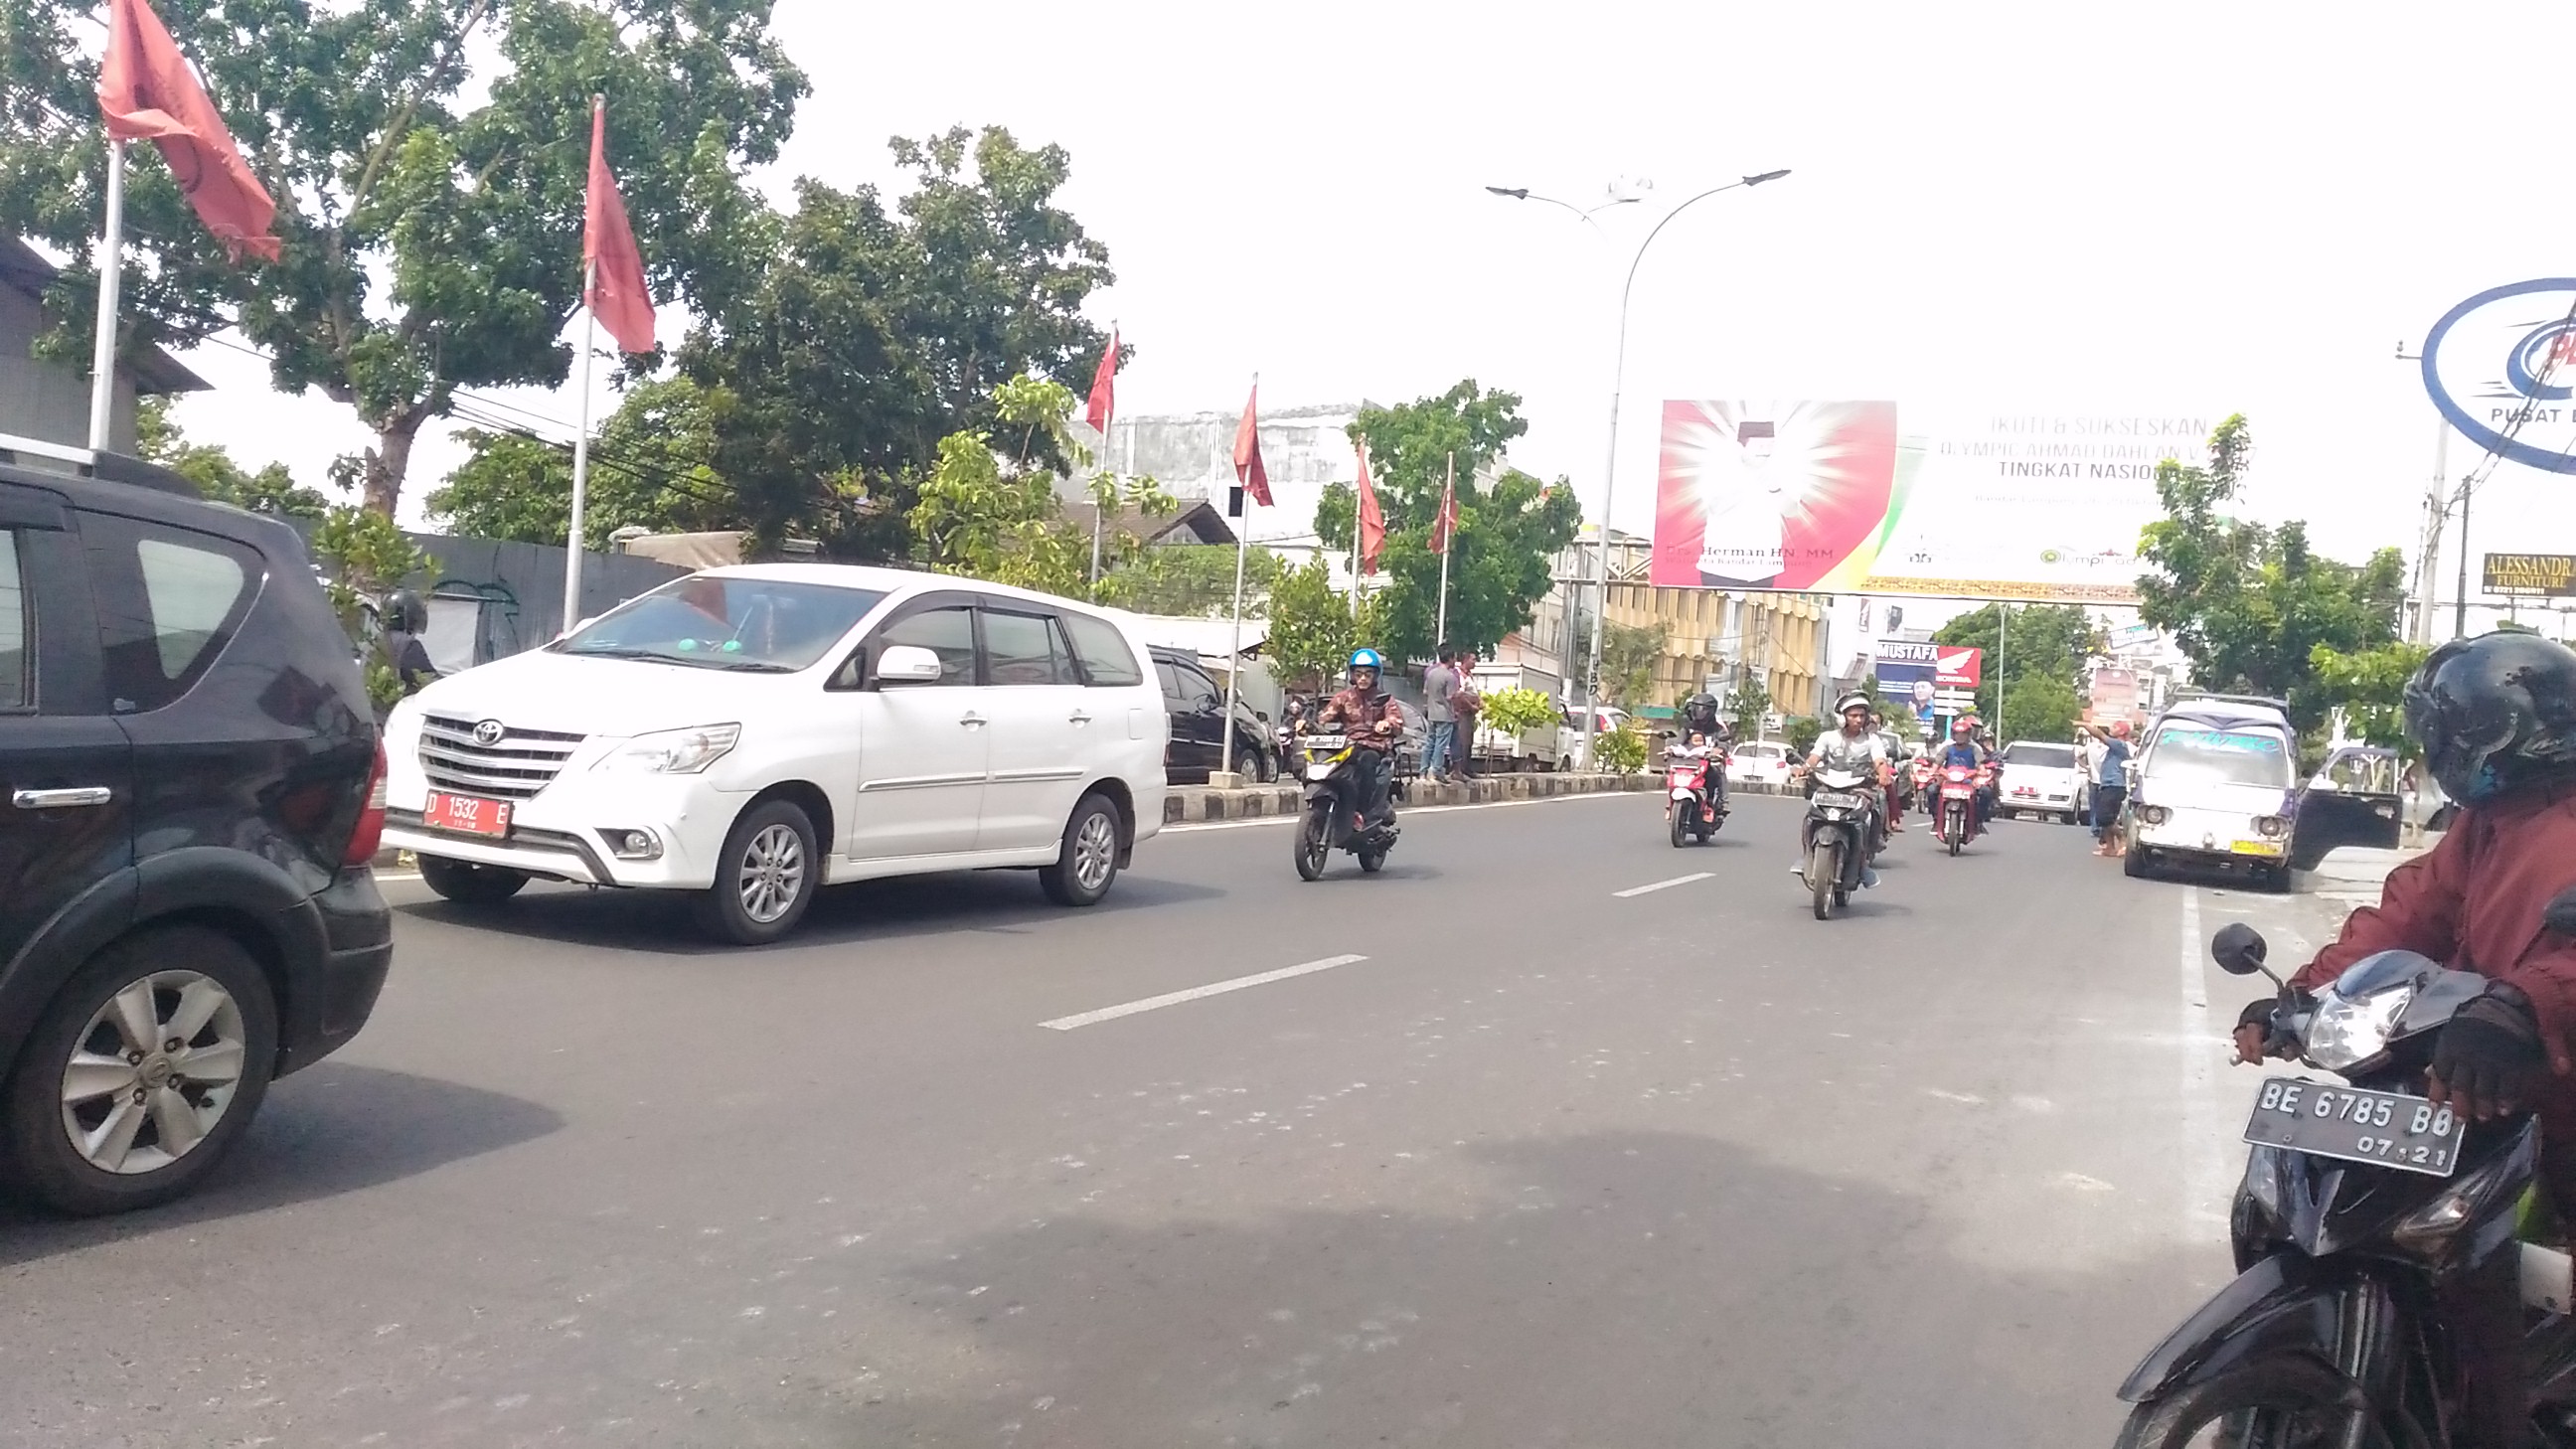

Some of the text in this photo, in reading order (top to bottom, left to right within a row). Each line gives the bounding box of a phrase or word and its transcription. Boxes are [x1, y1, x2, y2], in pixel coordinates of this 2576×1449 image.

[2491, 408, 2561, 423] PUSAT
[1992, 416, 2206, 436] IKUTI & SUKSESKAN
[1999, 461, 2157, 480] TINGKAT NASIO
[1701, 546, 1764, 557] Herman
[2496, 575, 2567, 588] FURNITURE
[1875, 644, 1939, 661] MUSTAFA
[427, 794, 507, 824] D 1532 E
[2260, 1082, 2303, 1114] BE
[2314, 1091, 2395, 1127] 6785
